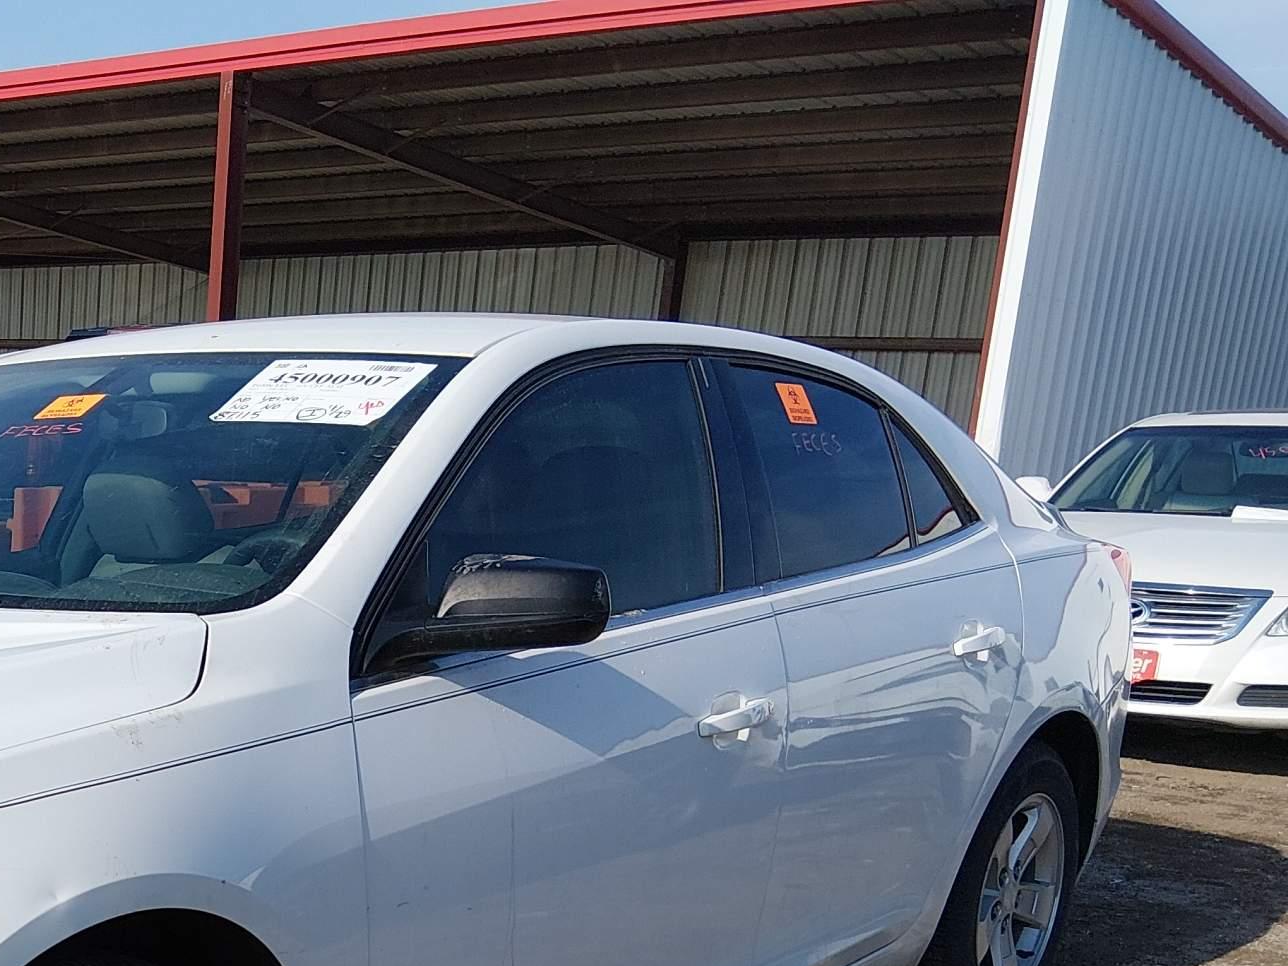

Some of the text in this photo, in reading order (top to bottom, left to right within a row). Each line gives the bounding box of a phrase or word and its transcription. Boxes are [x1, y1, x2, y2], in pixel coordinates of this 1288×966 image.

[268, 372, 402, 389] 45000907
[358, 400, 385, 416] yes
[791, 432, 842, 456] FECES
